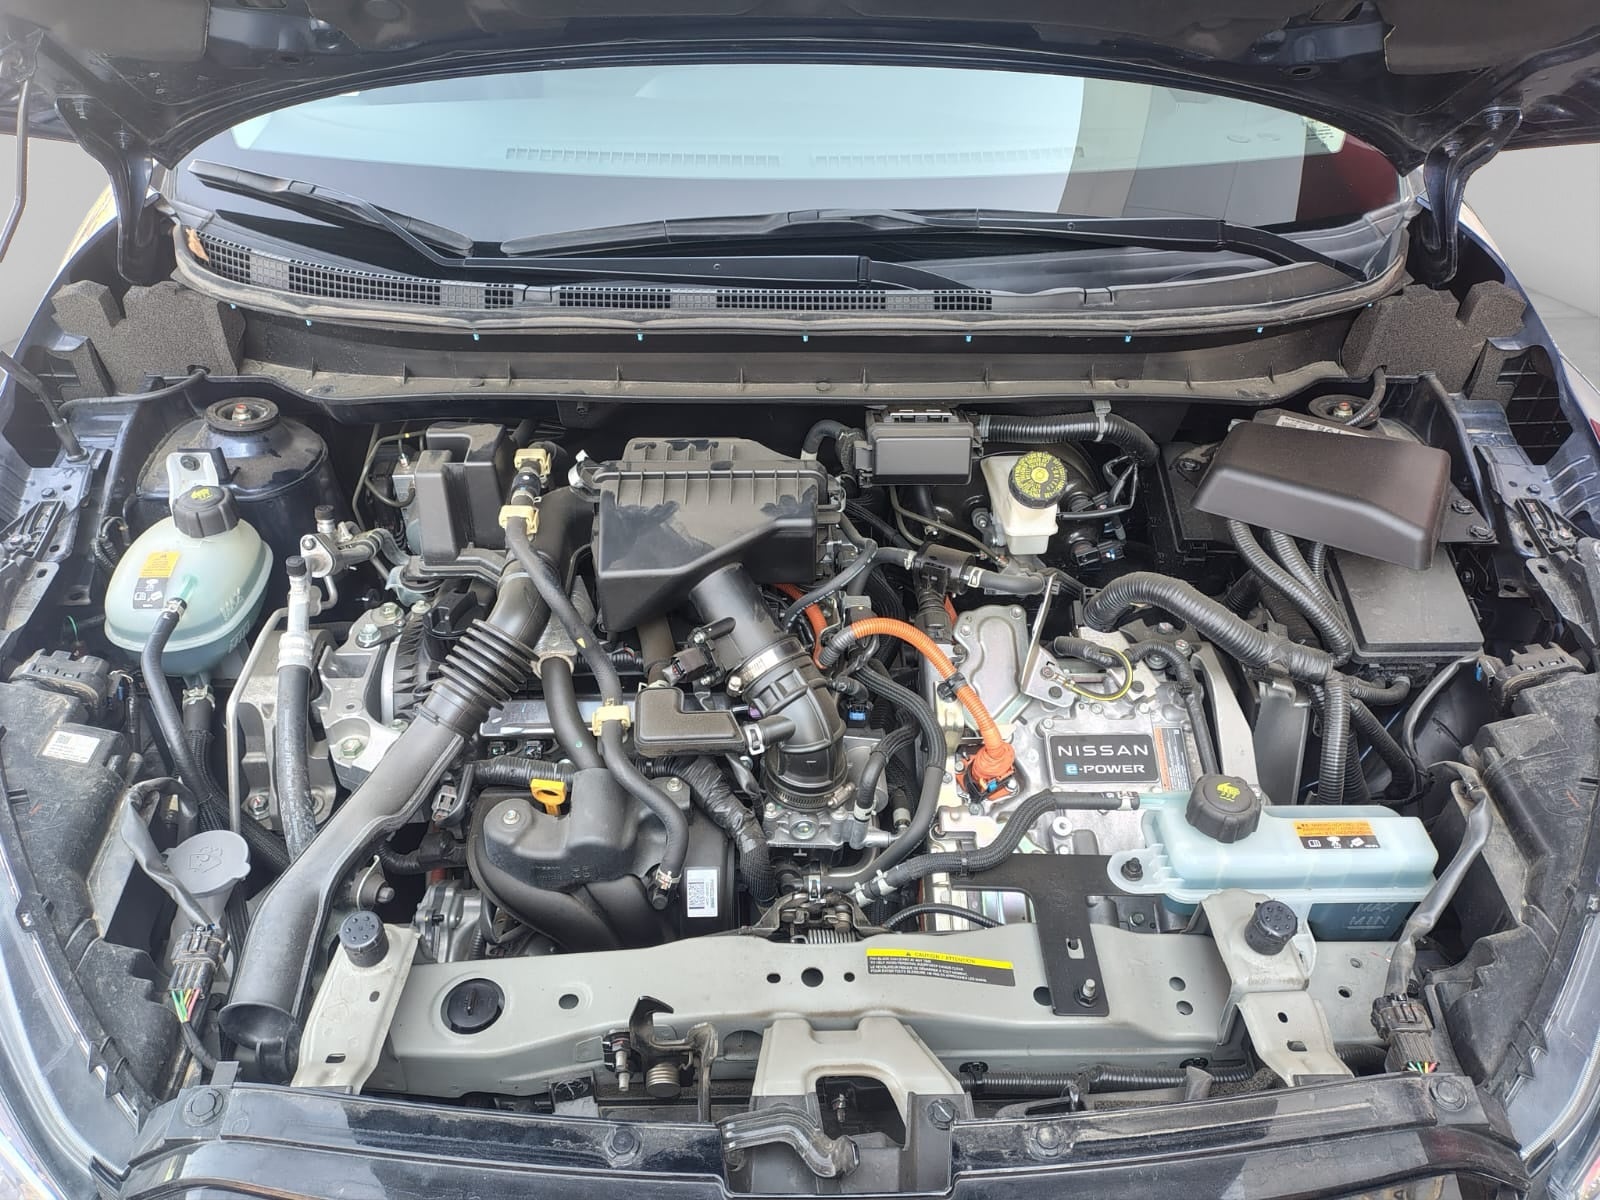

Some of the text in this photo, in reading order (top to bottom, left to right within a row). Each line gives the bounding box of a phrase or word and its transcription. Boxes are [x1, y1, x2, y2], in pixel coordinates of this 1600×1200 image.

[1058, 744, 1149, 757] NISSAN
[1065, 764, 1145, 775] e-POWER
[1349, 916, 1391, 926] MIN
[914, 951, 940, 960] CAUTION
